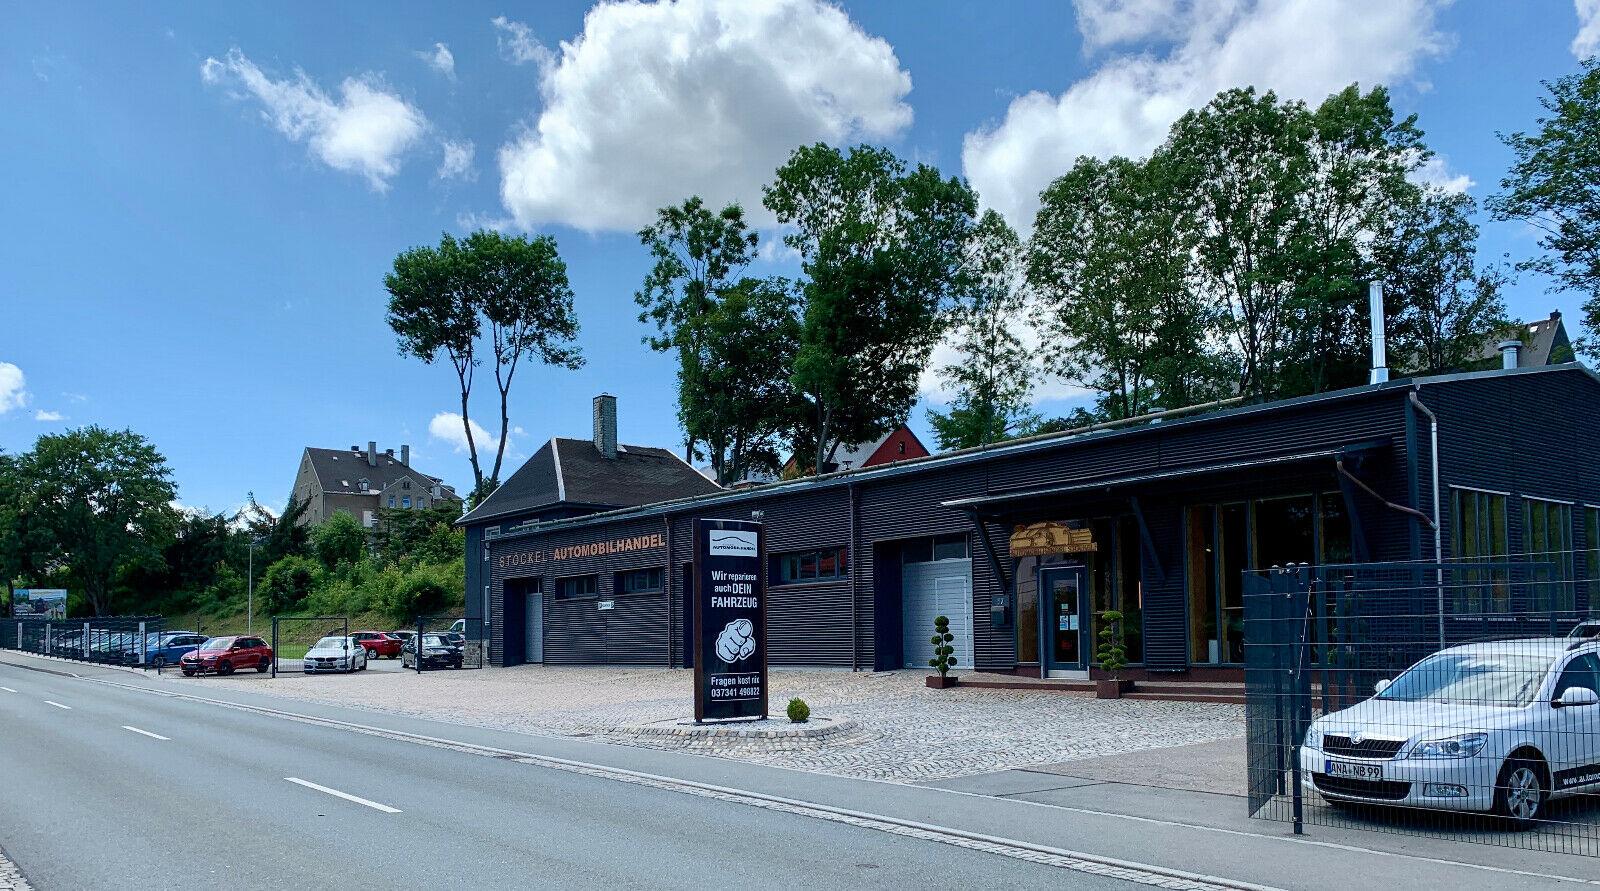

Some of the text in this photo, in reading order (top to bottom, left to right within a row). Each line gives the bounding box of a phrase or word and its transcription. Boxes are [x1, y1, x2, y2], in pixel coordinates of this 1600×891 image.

[499, 534, 666, 568] STÖCKEL AUTOMOBILHANDEL
[711, 571, 727, 581] Wir
[714, 583, 752, 595] auch DEIN
[711, 596, 758, 608] FAHRZEUG
[711, 676, 737, 687] Fragen
[737, 675, 751, 685] kost
[711, 688, 737, 698] 037341
[1331, 763, 1348, 775] ANA
[1353, 765, 1366, 777] NB
